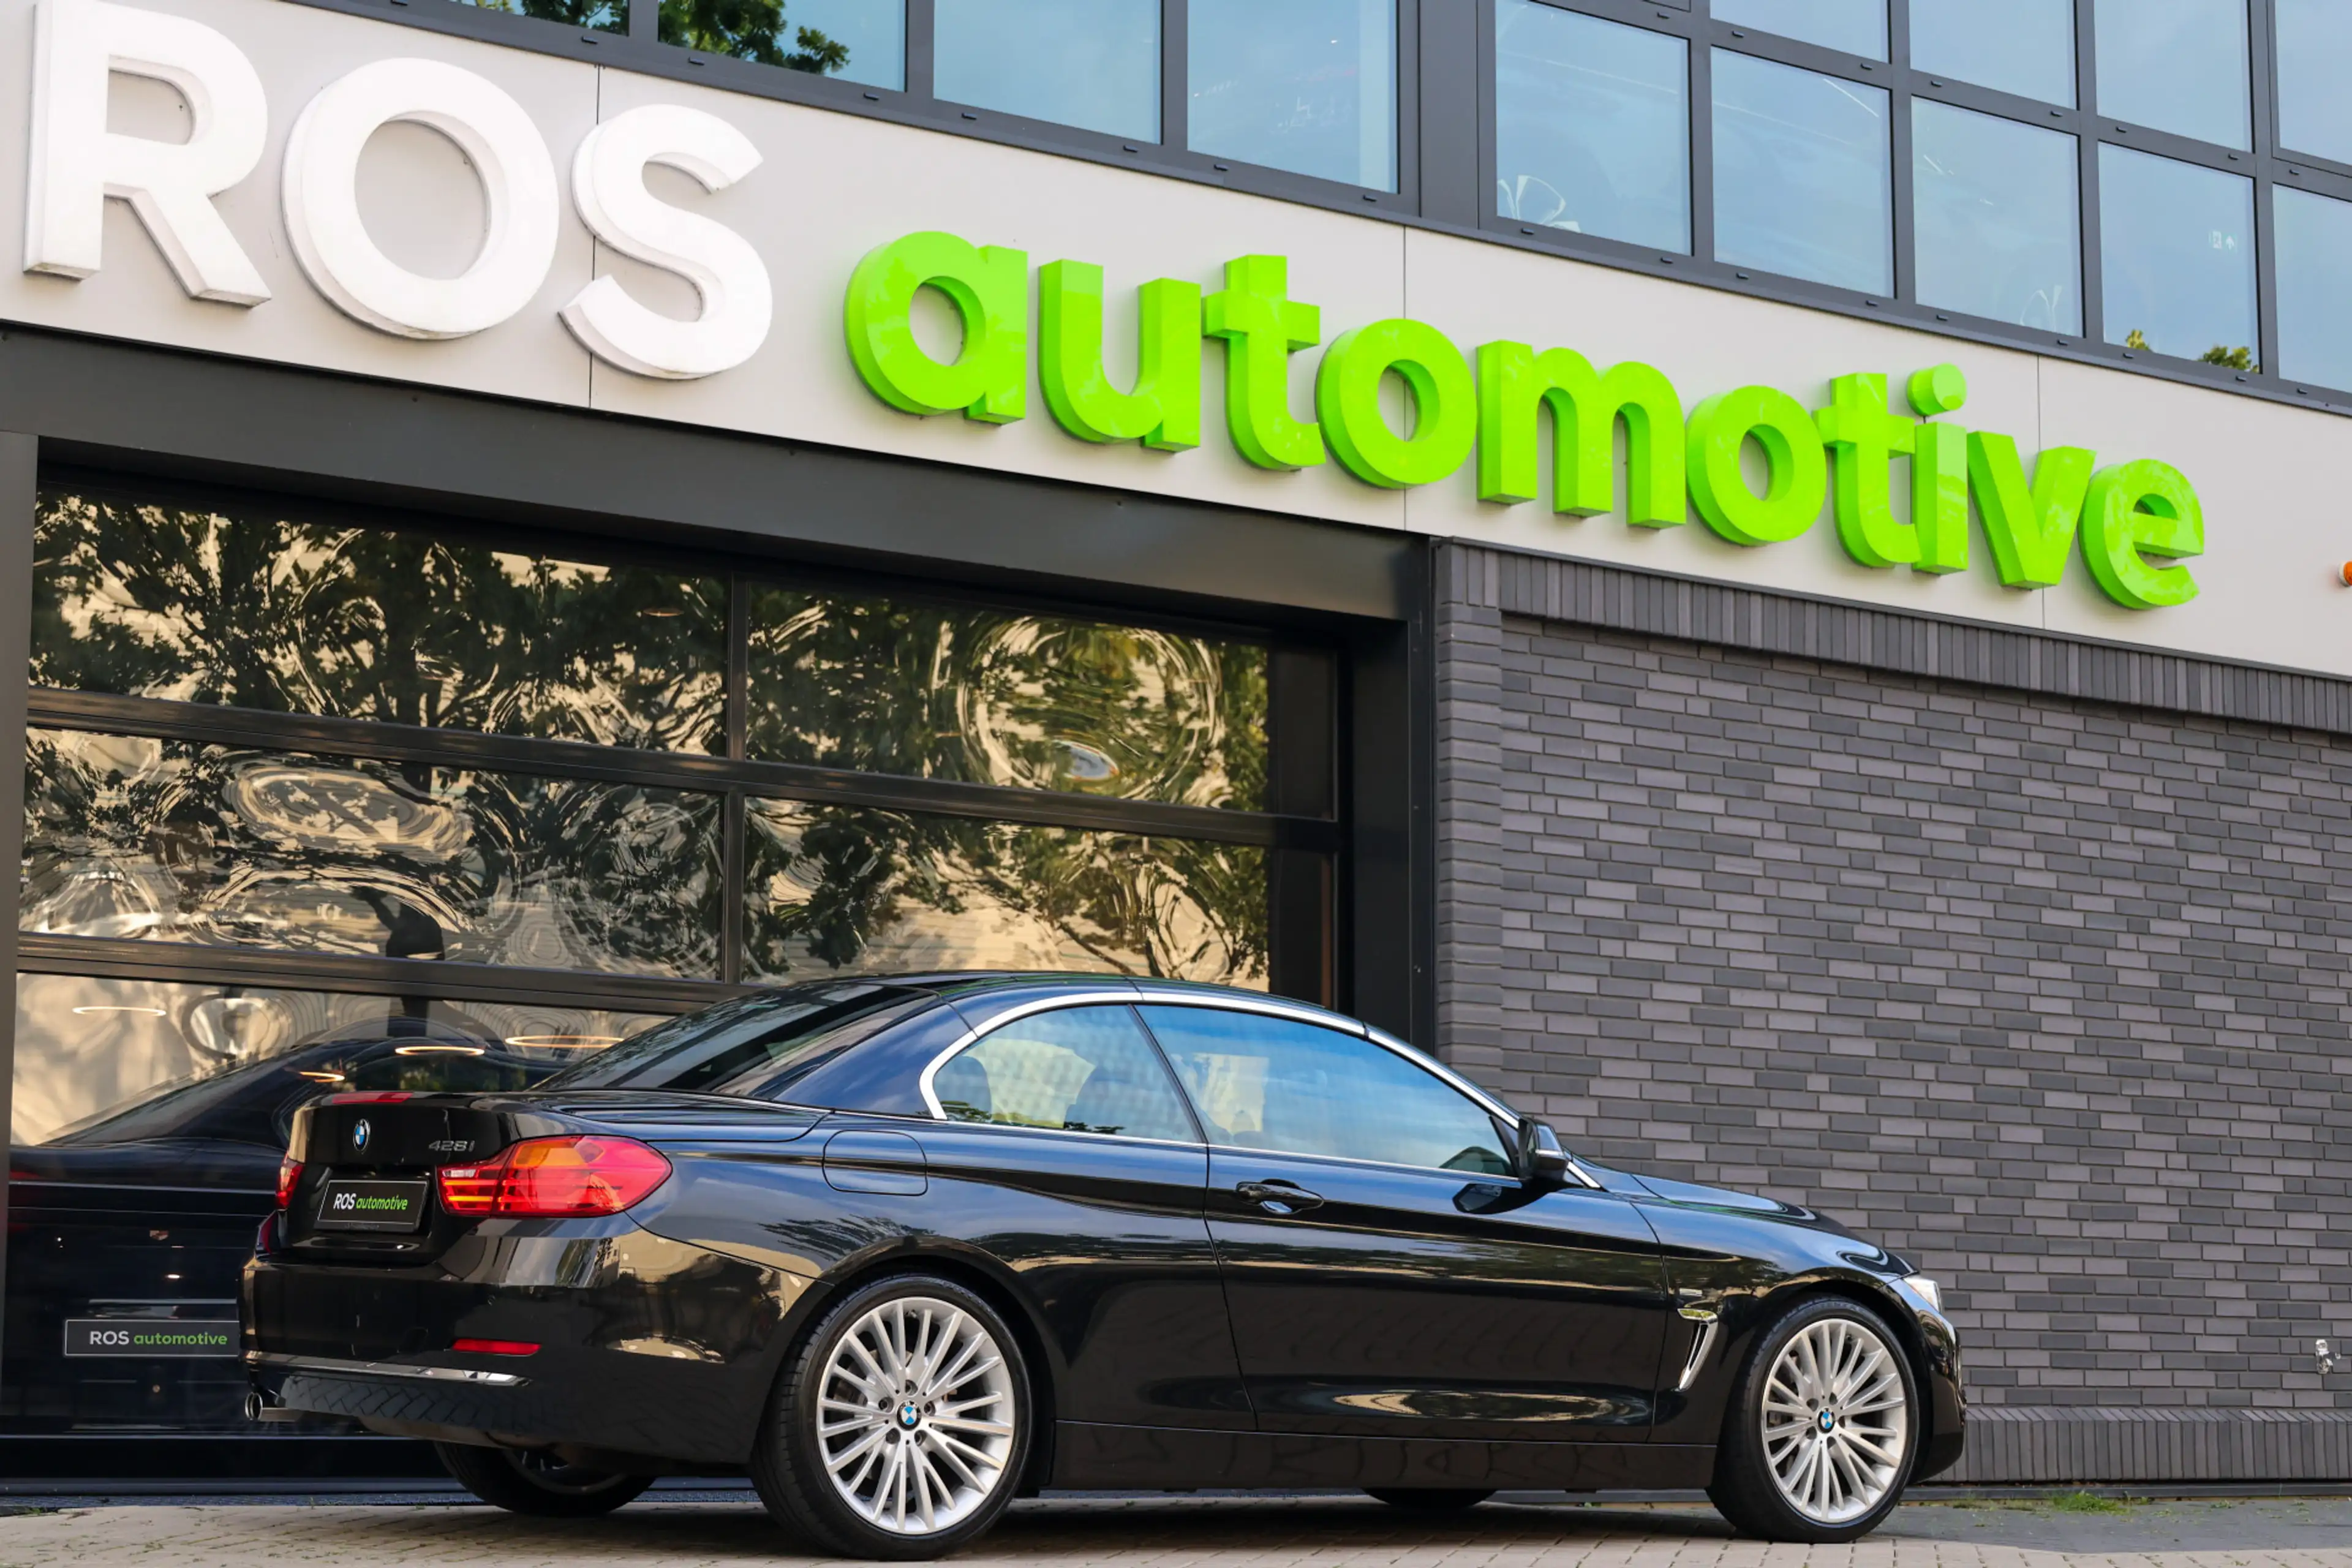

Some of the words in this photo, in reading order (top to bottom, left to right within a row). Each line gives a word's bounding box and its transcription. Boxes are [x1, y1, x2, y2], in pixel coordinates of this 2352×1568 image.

[23, 1, 773, 380] ROS
[844, 231, 2204, 609] automotive
[333, 1193, 356, 1210] ROS
[356, 1196, 408, 1210] automotive
[89, 1331, 129, 1345] ROS
[134, 1332, 227, 1344] automotive
